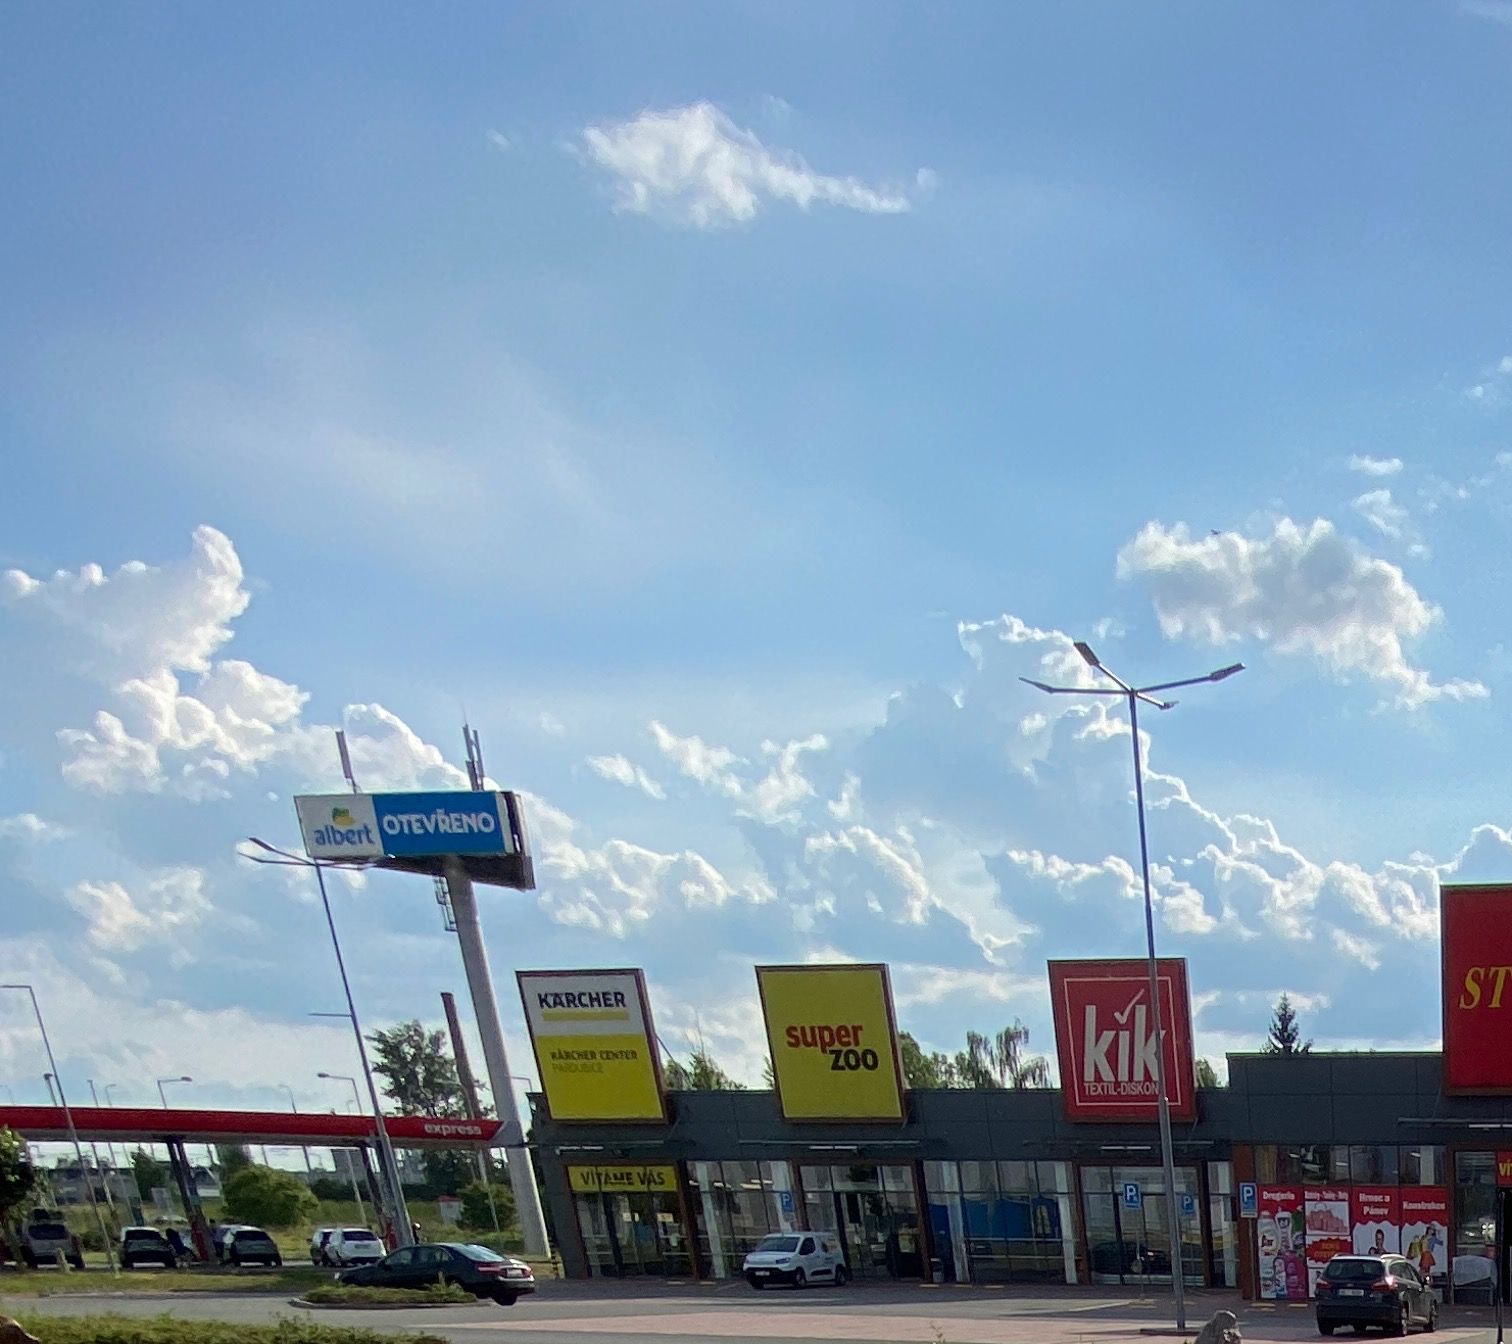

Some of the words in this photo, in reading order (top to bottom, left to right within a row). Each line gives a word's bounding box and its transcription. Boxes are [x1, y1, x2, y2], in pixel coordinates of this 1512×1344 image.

[382, 808, 495, 835] OTEVŘENO
[313, 824, 375, 846] albert
[537, 991, 627, 1008] KÄRCHER
[785, 1024, 863, 1054] super
[599, 1049, 638, 1060] CENTER
[1084, 1082, 1160, 1096] TEXTIL-DISKON
[424, 1123, 482, 1137] express
[637, 1170, 665, 1185] VÁS
[1127, 1186, 1137, 1200] P
[1244, 1187, 1253, 1202] P
